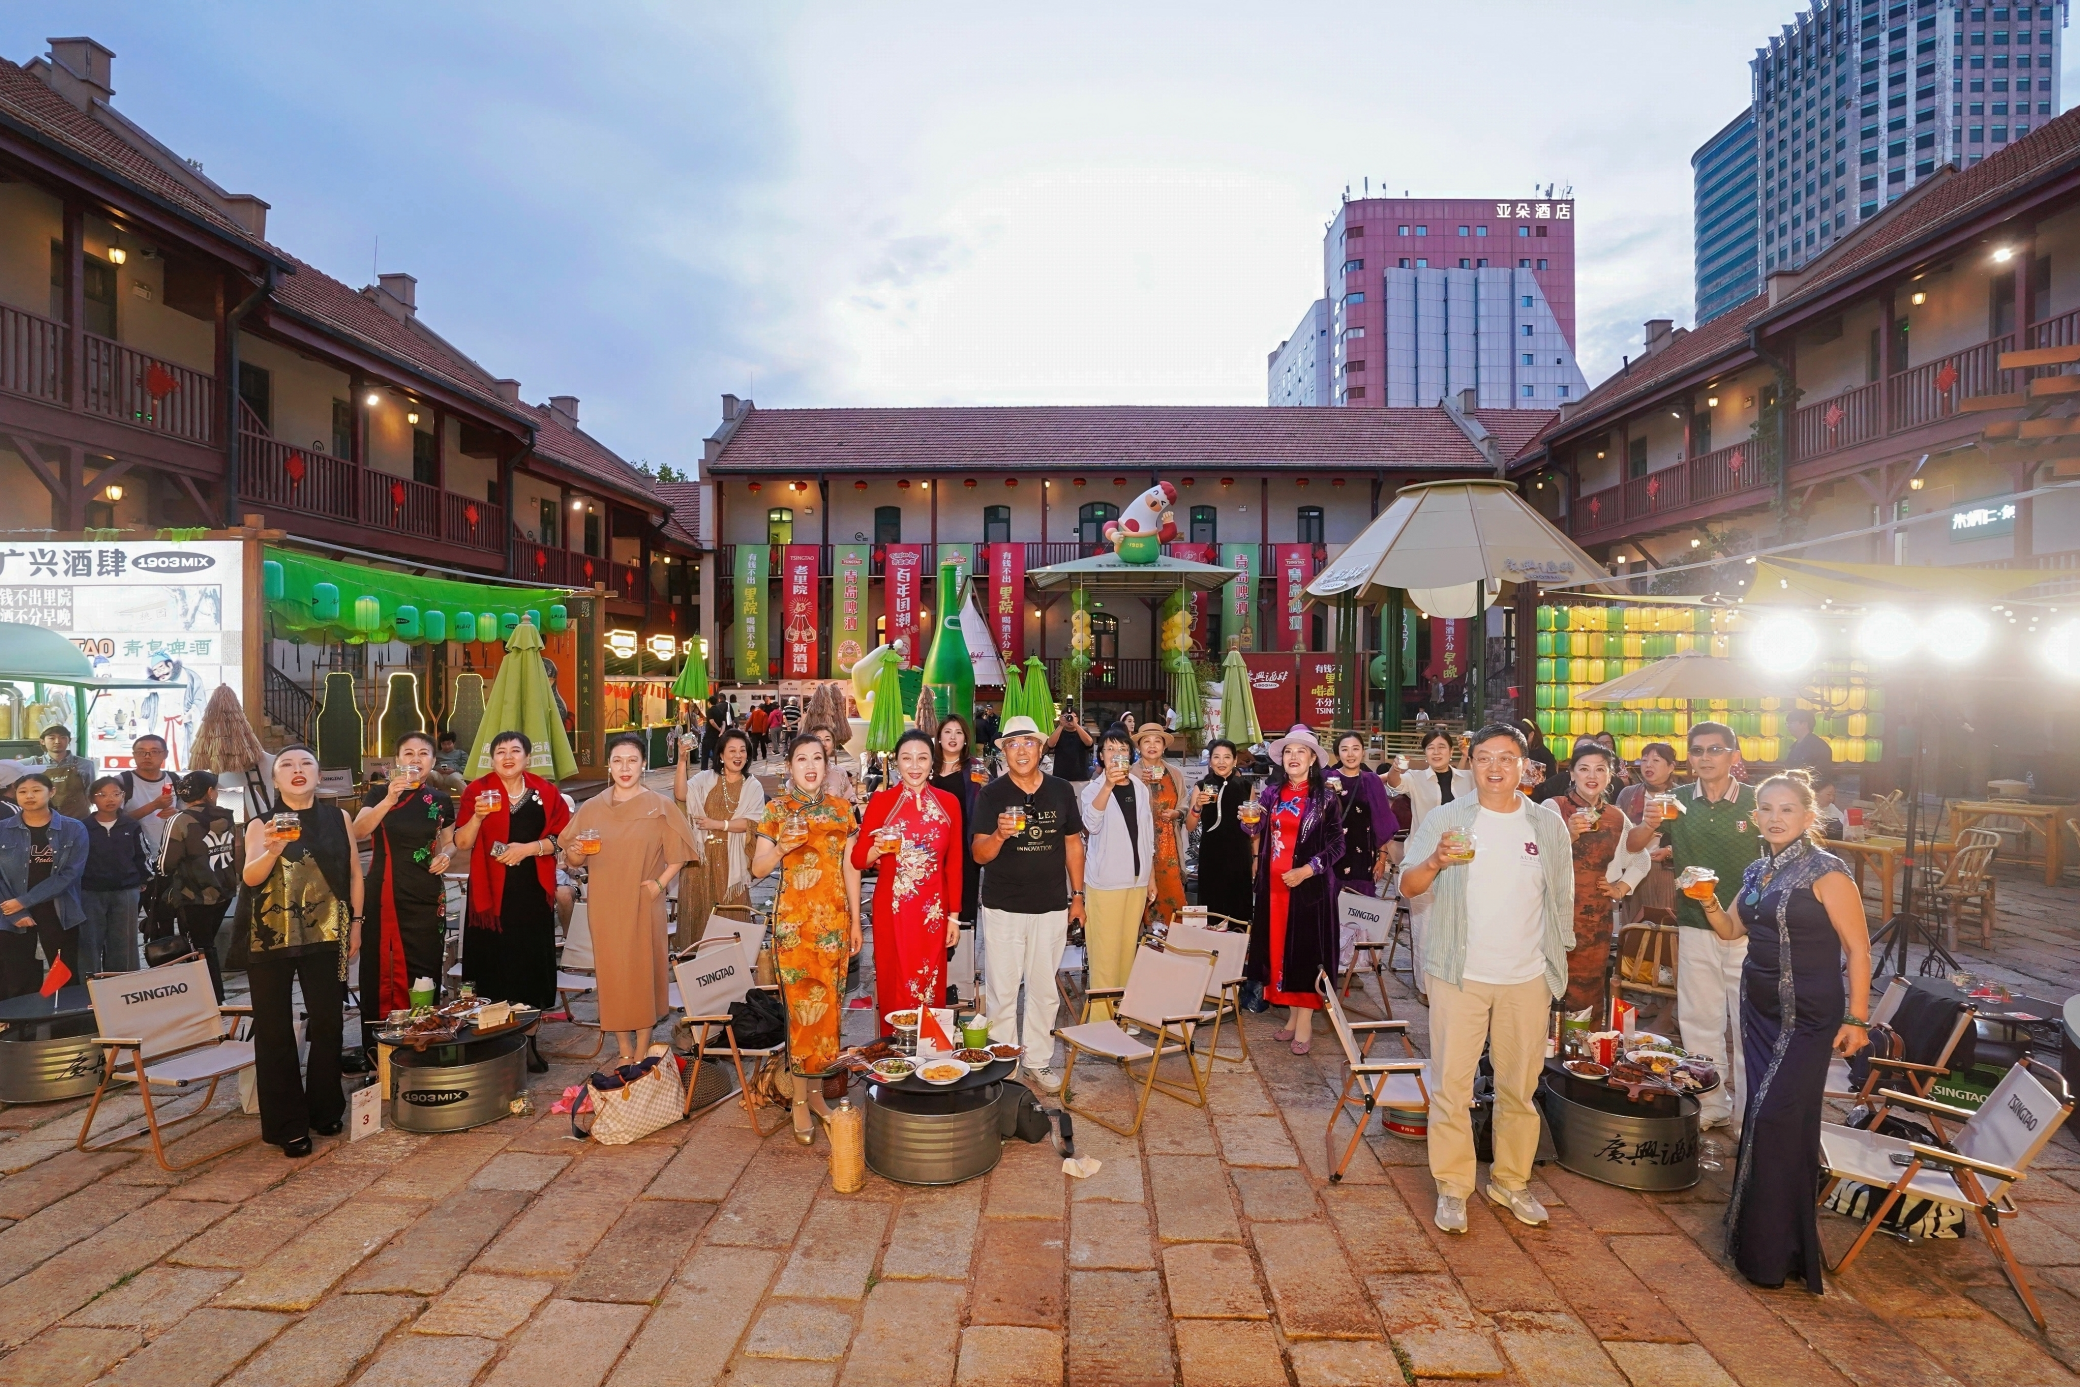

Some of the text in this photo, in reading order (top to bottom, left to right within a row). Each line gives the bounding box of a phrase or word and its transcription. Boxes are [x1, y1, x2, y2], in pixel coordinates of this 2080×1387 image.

[1496, 203, 1571, 220] 亚朵酒店
[0, 548, 127, 577] 广兴酒肆
[138, 556, 209, 568] 1903MIX
[792, 565, 808, 595] 老里院
[1235, 554, 1249, 615] 青岛啤酒
[843, 569, 858, 631] 青岛啤酒
[895, 567, 911, 628] 百年国潮
[998, 551, 1014, 667] 有钱不出里院喝酒不分早
[1288, 568, 1303, 630] 青岛啤酒
[792, 644, 808, 673] 新酒局
[1347, 907, 1380, 923] TSINGTAO
[695, 965, 735, 988] TSINGTAO
[121, 982, 188, 1005] TSINGTAO
[405, 1091, 462, 1103] 1903MIX
[362, 1114, 370, 1125] 3
[2007, 1093, 2038, 1132] TSINGTAO
